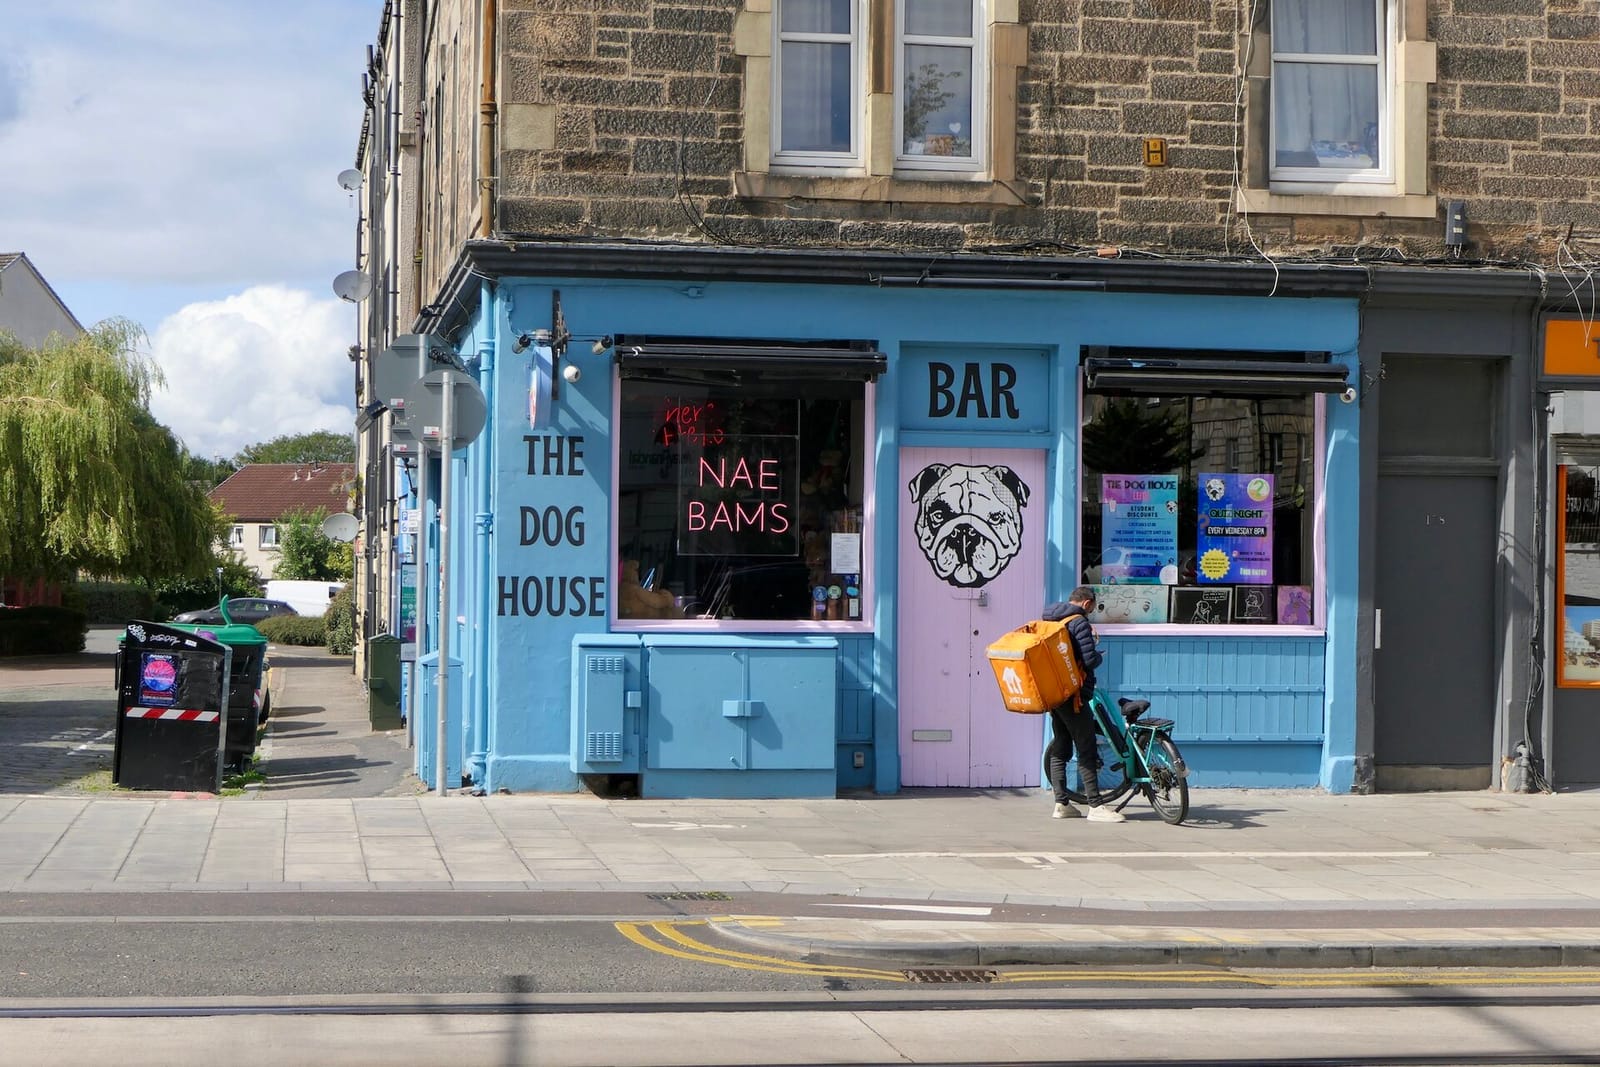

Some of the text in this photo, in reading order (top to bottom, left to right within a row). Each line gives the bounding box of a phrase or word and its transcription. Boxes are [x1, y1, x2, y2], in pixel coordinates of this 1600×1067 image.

[928, 361, 1020, 419] BAR
[523, 435, 584, 476] THE
[699, 456, 779, 490] NAE
[1107, 480, 1177, 490] THE DOG HOUSE
[520, 505, 585, 547] DOG
[688, 500, 790, 534] BAMS
[1207, 526, 1225, 536] EVERY
[1225, 527, 1253, 536] WEDNESDAY
[1233, 510, 1263, 518] NIGHT
[497, 575, 606, 617] HOUSE
